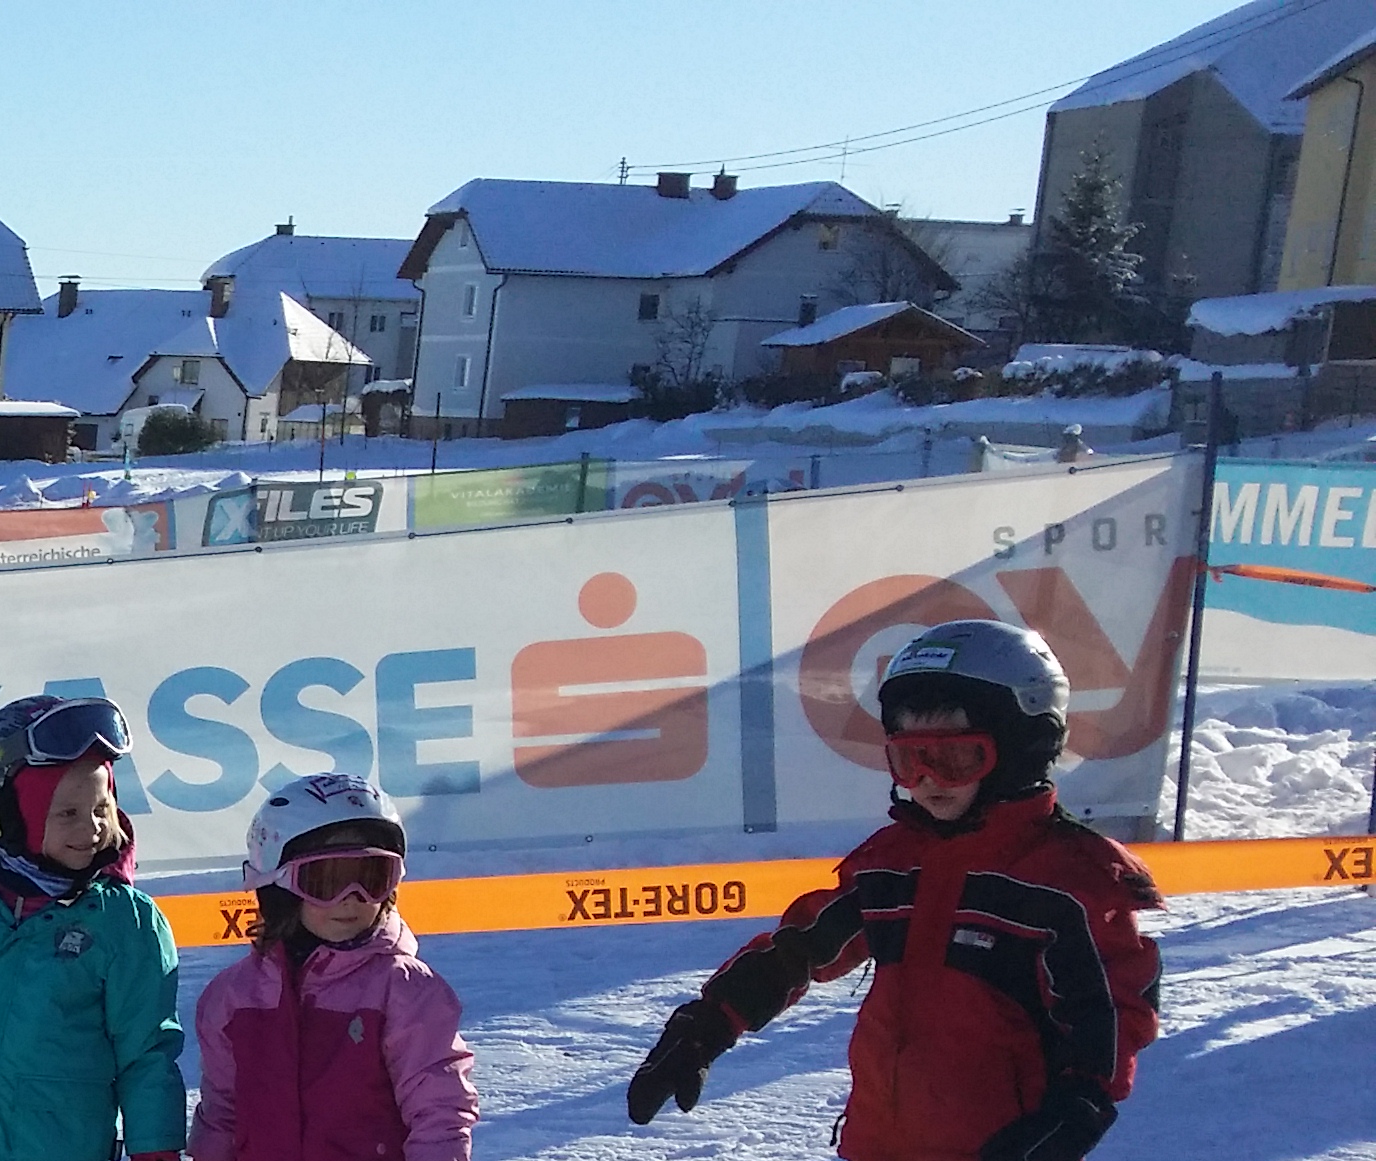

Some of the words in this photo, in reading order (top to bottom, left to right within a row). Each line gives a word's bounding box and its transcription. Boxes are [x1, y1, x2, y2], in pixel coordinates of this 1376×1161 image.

[340, 521, 369, 535] LIFE
[992, 510, 1202, 560] SPOR
[1209, 482, 1376, 549] MME
[566, 880, 747, 921] GORE-TEX
